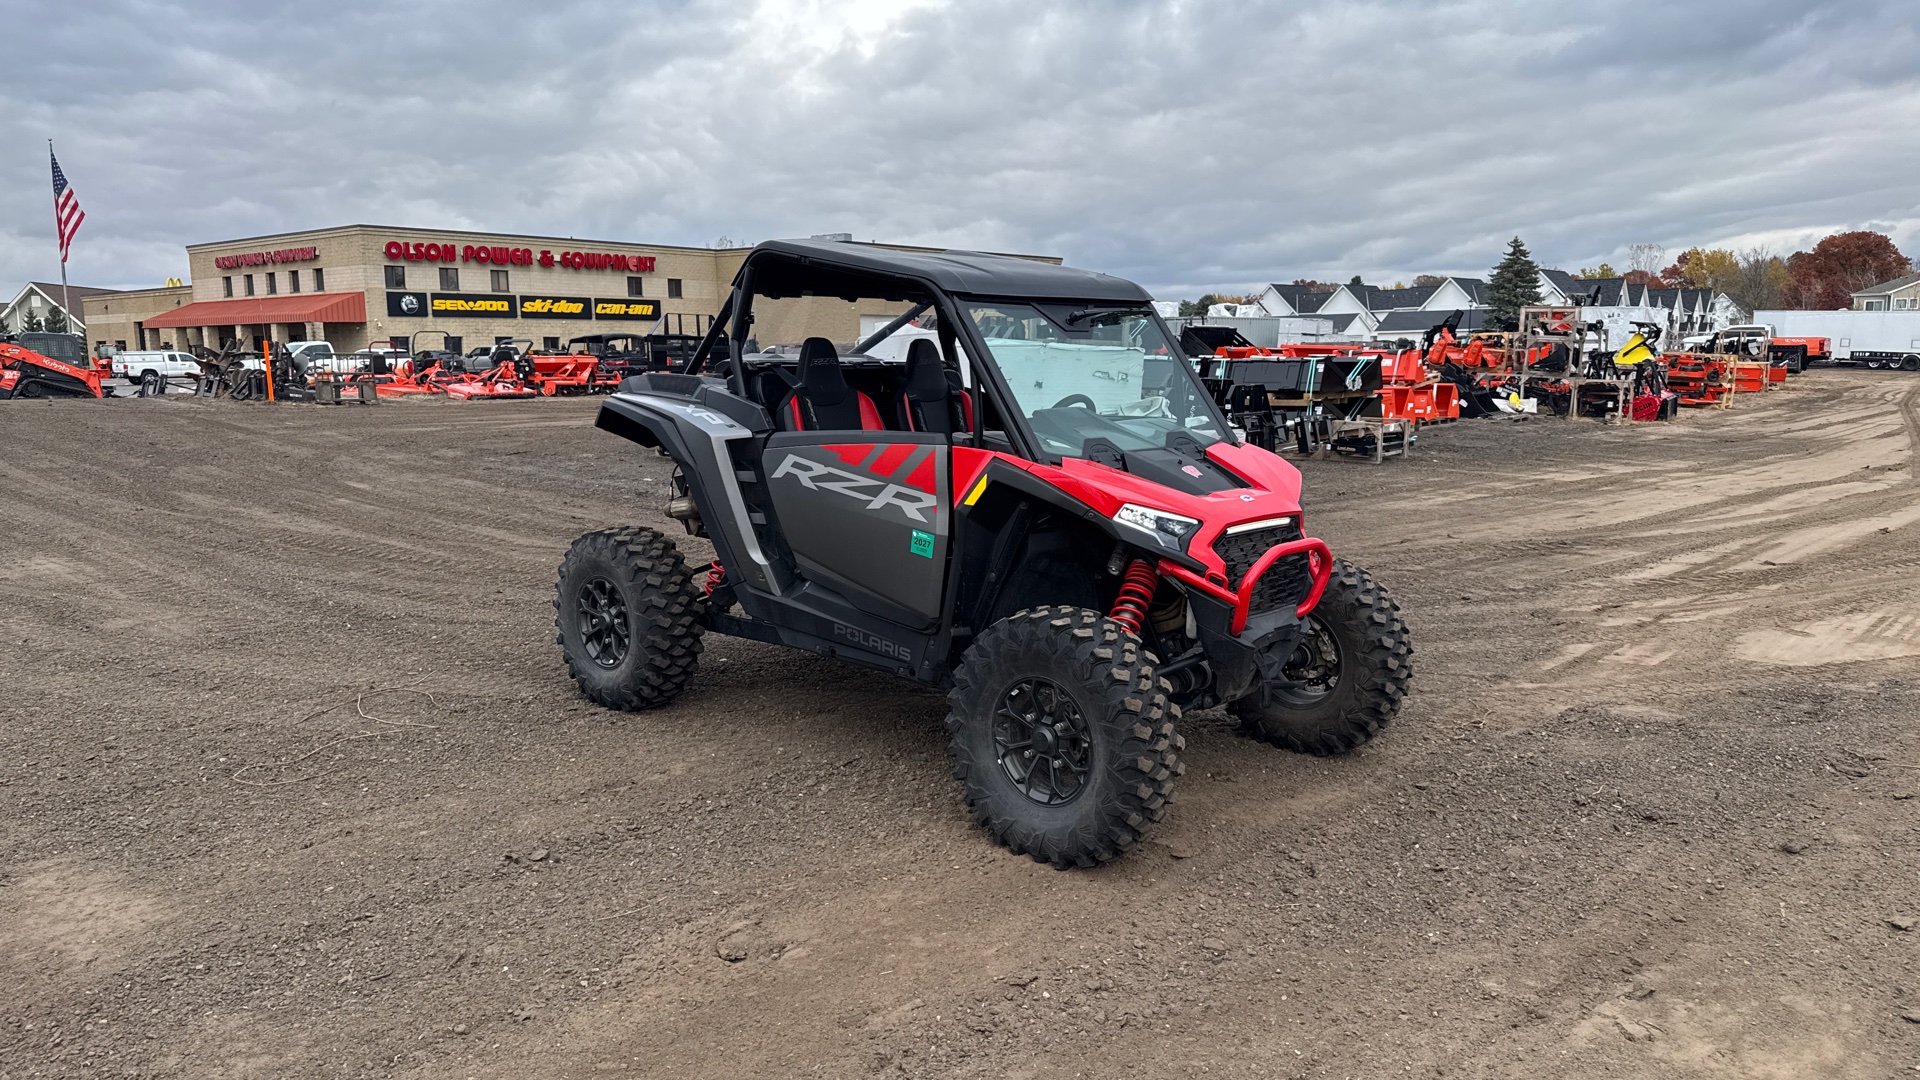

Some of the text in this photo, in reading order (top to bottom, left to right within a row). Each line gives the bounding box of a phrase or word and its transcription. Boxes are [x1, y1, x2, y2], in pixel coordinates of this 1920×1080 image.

[385, 241, 656, 272] OLSON POWER & EQUIPMENT
[521, 299, 584, 313] ski-doo
[596, 303, 654, 315] can-am
[771, 453, 938, 523] RZR
[914, 537, 931, 548] 2027
[834, 623, 911, 662] POLARIS
